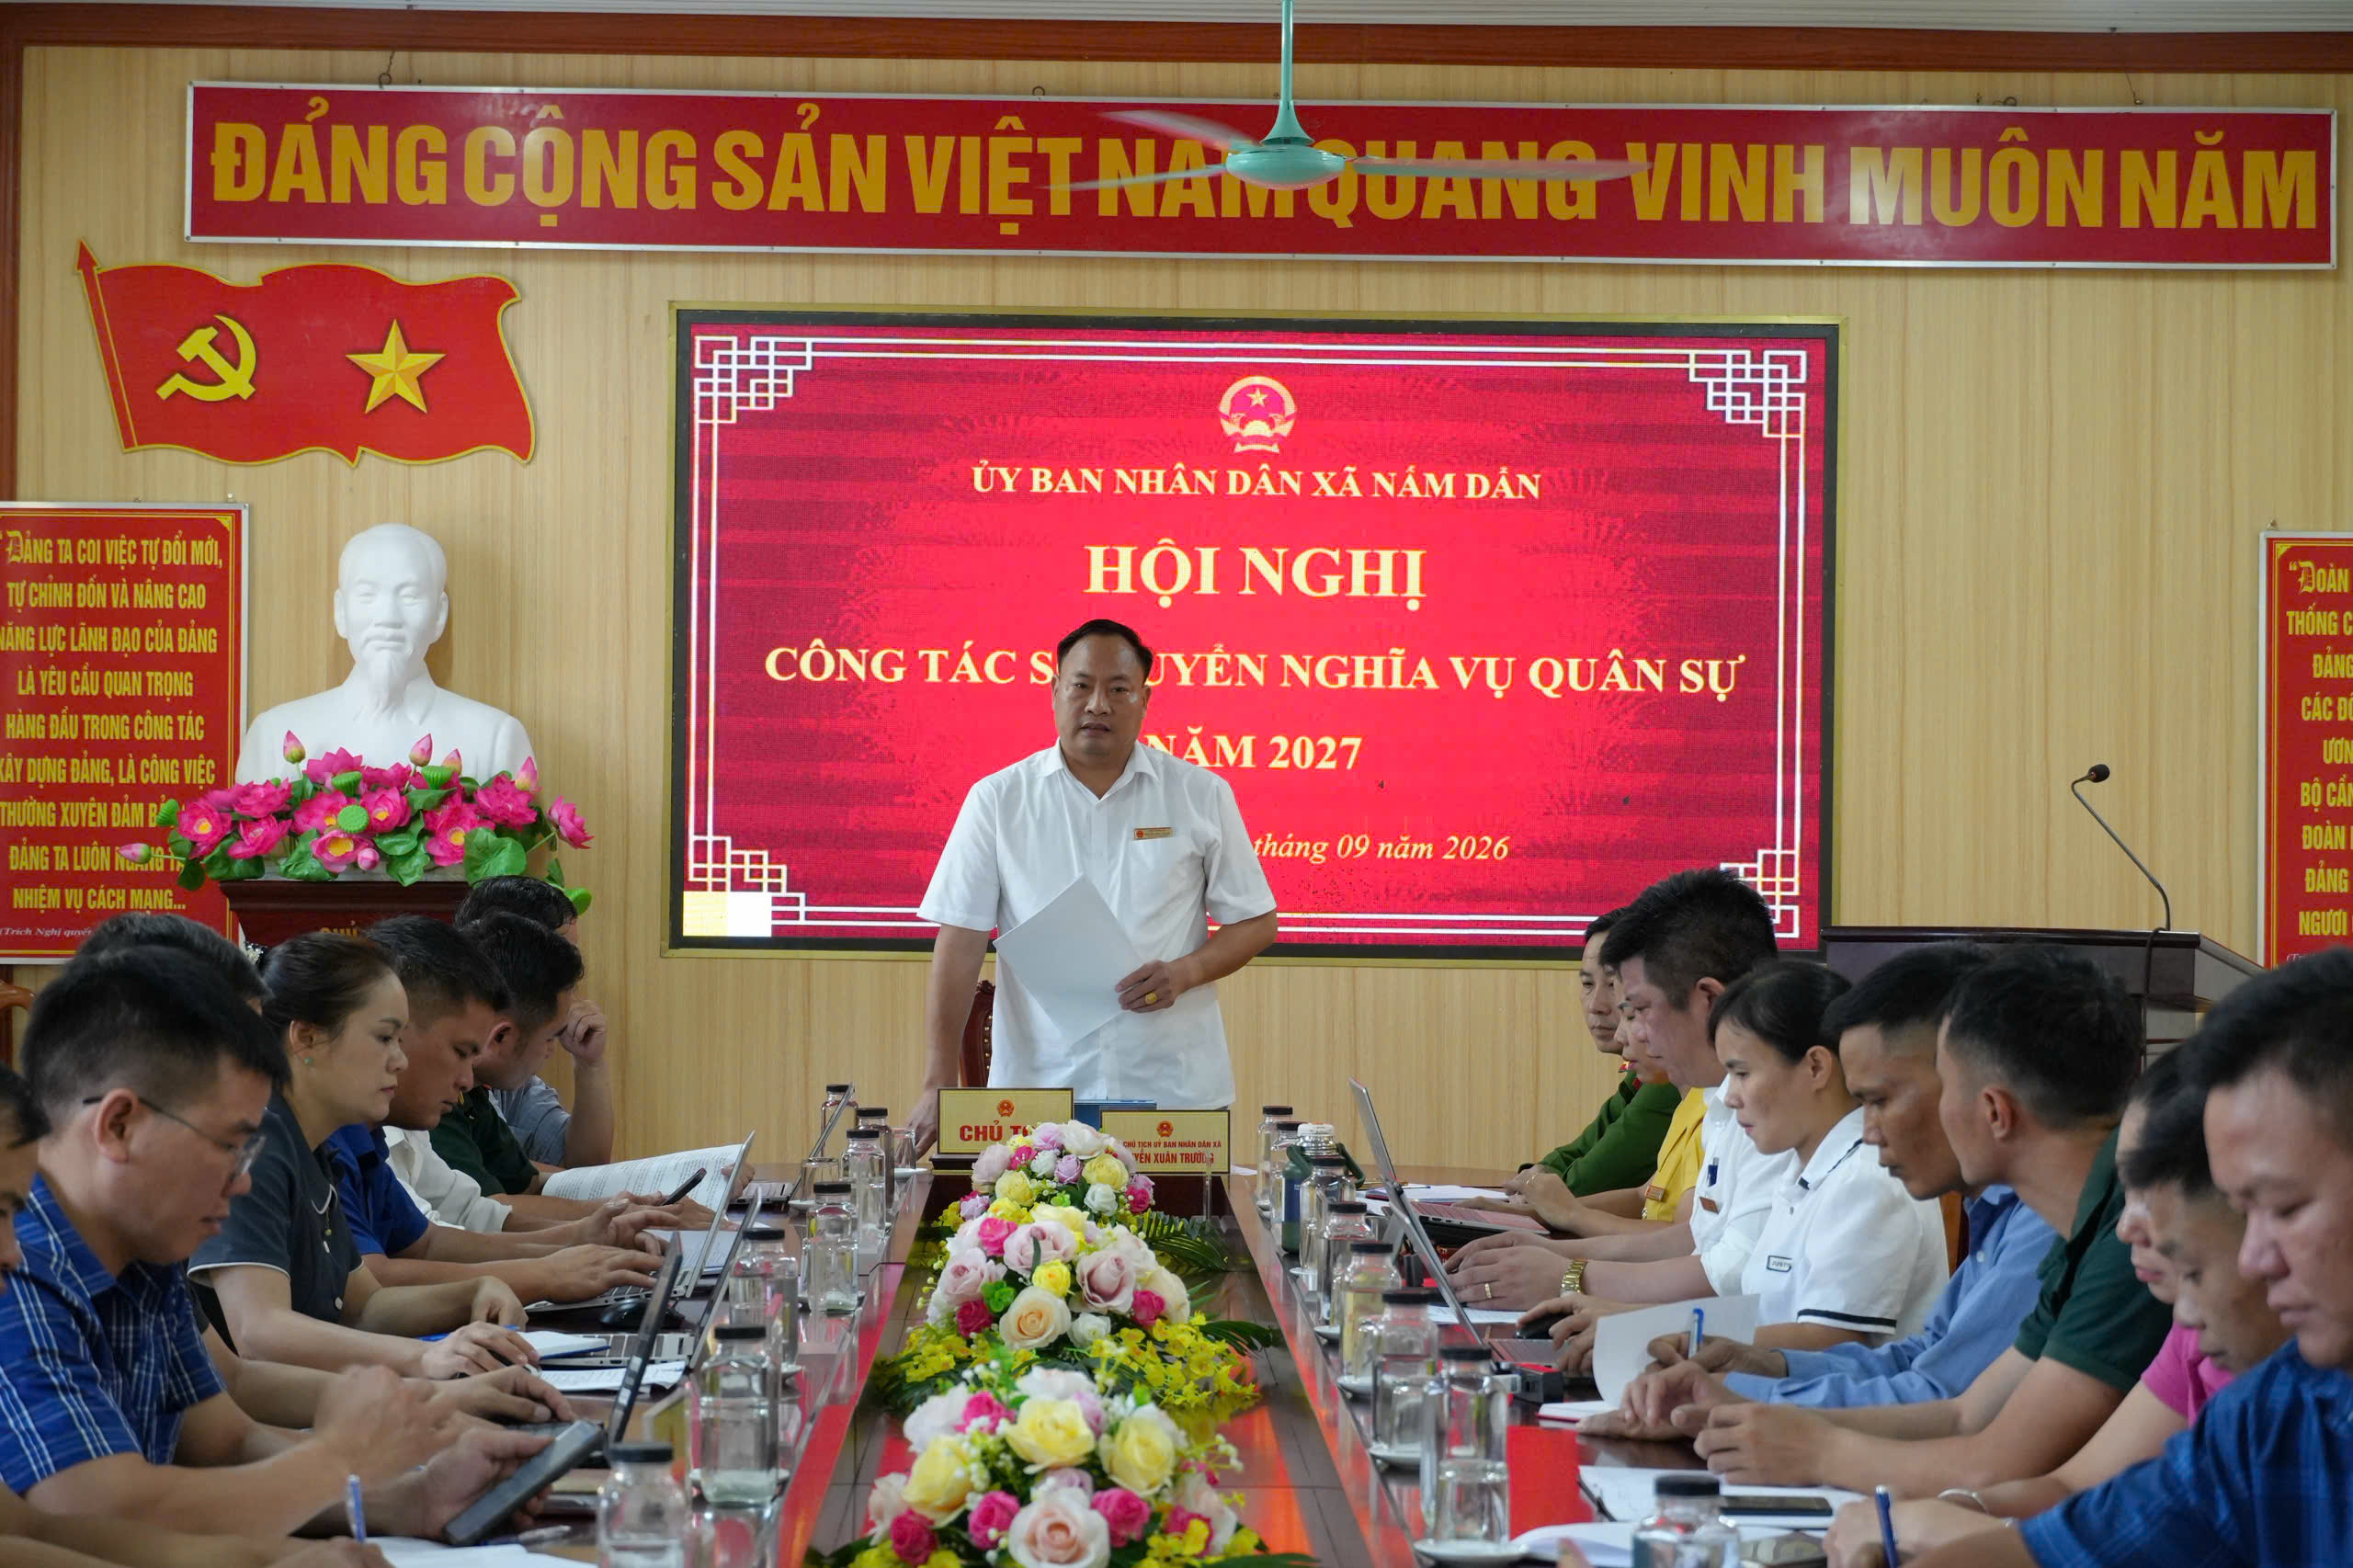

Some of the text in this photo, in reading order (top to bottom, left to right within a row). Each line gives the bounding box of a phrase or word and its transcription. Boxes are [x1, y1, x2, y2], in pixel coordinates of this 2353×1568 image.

[211, 97, 447, 204] ĐẢNG
[463, 104, 697, 227] CỘNG
[712, 102, 887, 212] SẢN
[904, 116, 1082, 235] VIỆT
[1307, 140, 1597, 229] QUANG
[1626, 142, 1824, 222] VINH
[1847, 128, 2104, 227] MUÔN
[2120, 131, 2316, 229] NĂM
[972, 460, 1022, 493] ỦY
[1030, 468, 1103, 494] BAN
[1114, 462, 1217, 494] NHÂN
[1227, 463, 1302, 495] DÂN
[1312, 466, 1362, 497] XÃ
[1372, 465, 1457, 498] NẤM
[57, 539, 74, 563] TA
[77, 539, 101, 564] COI
[105, 534, 137, 570] VIỆC
[141, 538, 160, 570] TỰ
[163, 529, 187, 566] ĐỔI
[190, 534, 223, 568] MỚI,
[1084, 538, 1427, 611] HỘI NGHỊ
[7, 574, 207, 613] TỰ CHỈNH ĐỐN VÀ NÂNG CAO
[2286, 602, 2339, 636] THỐNG
[39, 624, 67, 657] LỰC
[71, 621, 108, 652] LÃNH
[112, 627, 142, 658] ĐẠO
[145, 619, 175, 653] CỦA
[177, 619, 218, 653] ĐẢNG
[17, 662, 194, 702] LÀ YÊU CẦU QUAN TRỌNG
[765, 639, 907, 683] CÔNG
[919, 641, 1017, 684] TÁC
[1145, 644, 1268, 687] UYỂN
[1280, 648, 1439, 690] NGHĨA
[1449, 656, 1516, 699] VỤ
[1529, 649, 1667, 699] QUÂN
[1679, 653, 1746, 702] SỰ
[6, 706, 205, 741] HÀNG ĐẦU TRONG CÔNG TÁC
[2301, 691, 2334, 722] CÁC
[28, 755, 67, 789] DỰNG
[71, 750, 115, 787] ĐẢNG,
[119, 754, 137, 784] LÀ
[141, 754, 180, 785] CÔNG
[184, 754, 216, 790] VIỆC
[1267, 735, 1362, 770] 2027
[0, 796, 57, 827] THƯỜNG
[61, 797, 108, 828] XUYÊN
[111, 794, 145, 828] ĐẢM
[2301, 777, 2323, 812] BỘ
[1254, 833, 1510, 865] tháng 09 năm 2026
[2302, 820, 2347, 850] ĐOÀN
[9, 837, 50, 871] ĐẢNG
[53, 846, 70, 871] TA
[74, 840, 111, 871] LUÔN
[2305, 859, 2350, 893] ĐẢNG
[14, 884, 61, 914] NHIỆM
[65, 888, 84, 914] VỤ
[87, 884, 126, 910] CÁCH
[960, 1119, 1003, 1142] CHỦ
[1178, 1140, 1197, 1148] NHÂN
[1154, 1151, 1177, 1164] XUÂN
[1180, 1151, 1214, 1164] TRƯỜG
